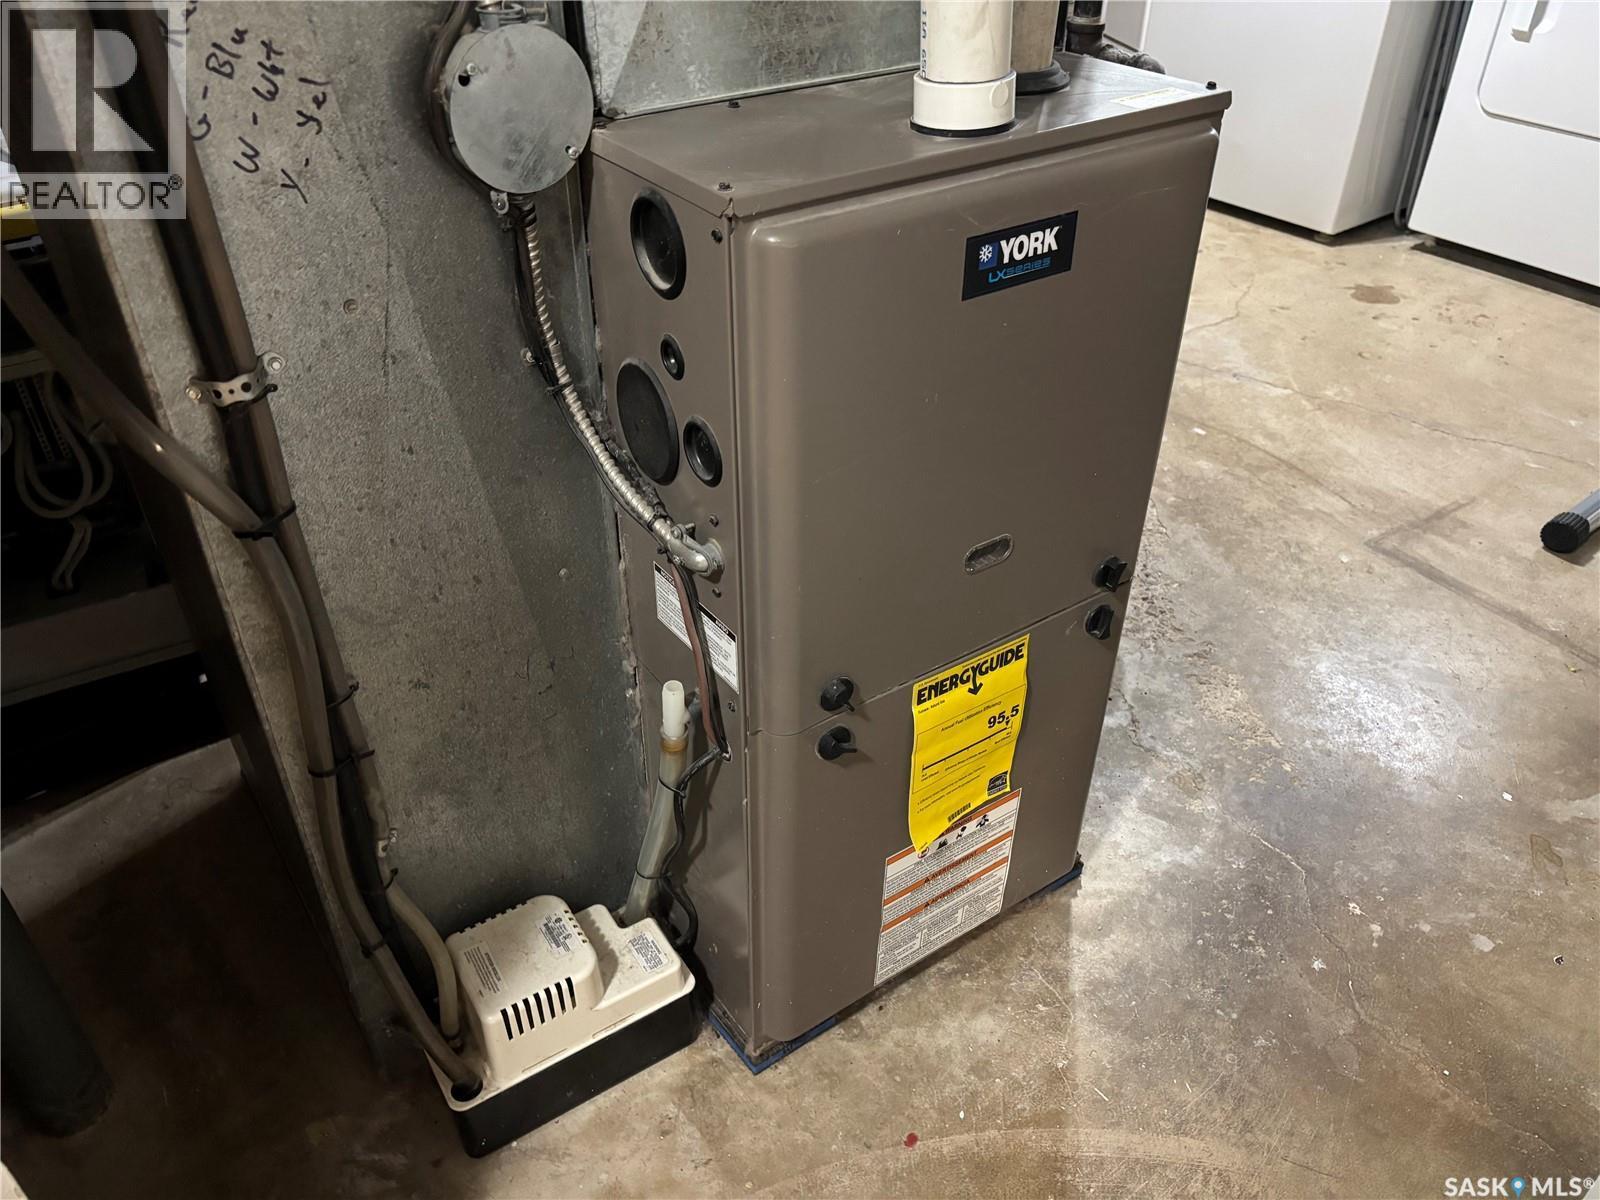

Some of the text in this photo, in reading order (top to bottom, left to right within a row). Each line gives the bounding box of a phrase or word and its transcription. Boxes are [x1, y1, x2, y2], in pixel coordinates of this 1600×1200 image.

[1000, 226, 1060, 265] YORK
[916, 642, 1026, 706] ENERGYGUIDE
[987, 704, 1020, 729] 95.5
